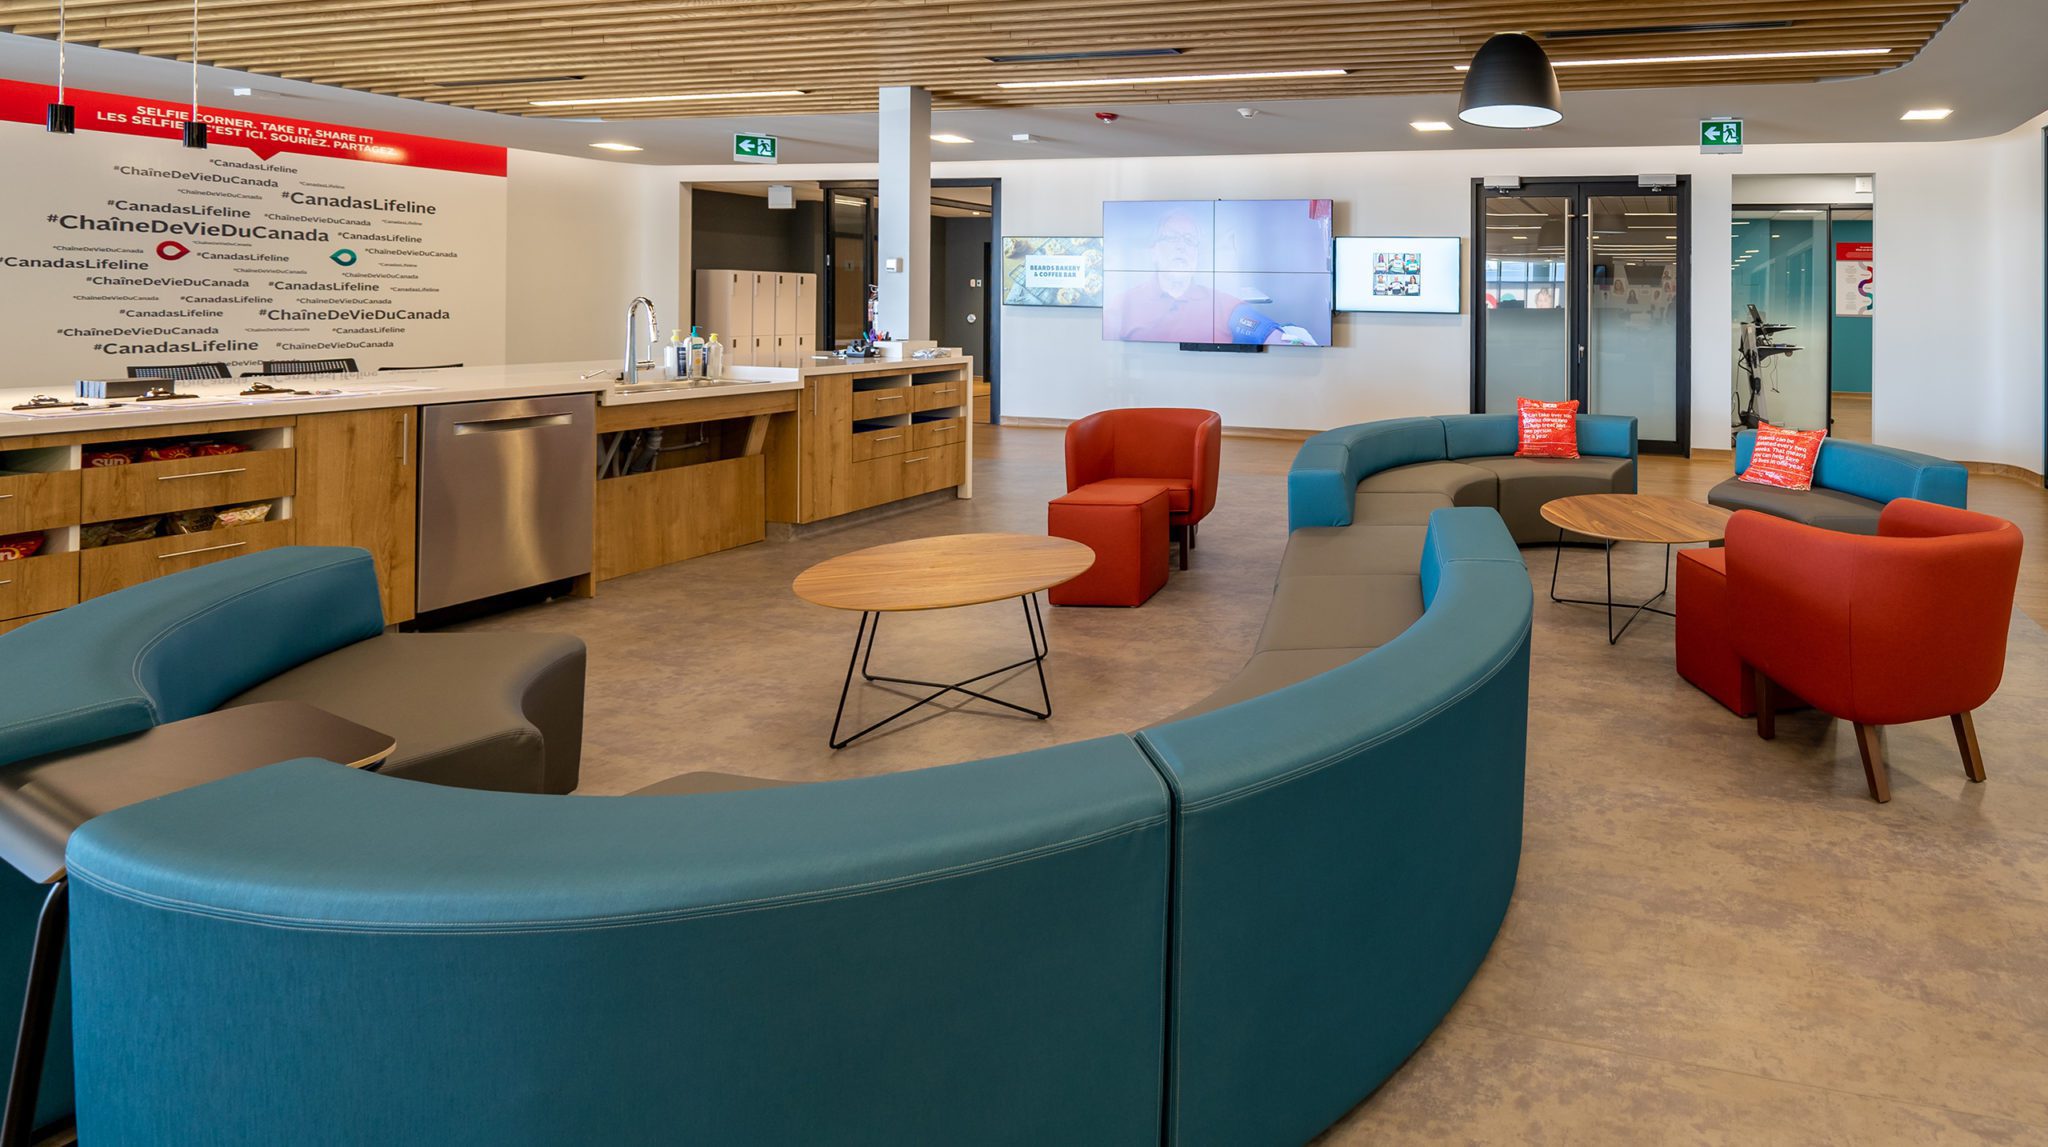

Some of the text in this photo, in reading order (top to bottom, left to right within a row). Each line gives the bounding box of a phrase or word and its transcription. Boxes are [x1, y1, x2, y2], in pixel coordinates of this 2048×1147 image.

[96, 111, 127, 122] LES
[131, 115, 185, 130] SELFIE
[246, 129, 267, 140] ICI.
[270, 133, 331, 148] SOURIEZ.
[136, 105, 189, 120] SELFIE
[195, 113, 257, 129] CORNER.
[260, 122, 295, 134] TAKE
[315, 129, 356, 142] SHARE
[359, 135, 374, 144] IT!
[209, 158, 298, 175] #CanadasLifeline
[113, 165, 279, 188] #ChaîneDeVieDuCanada
[107, 199, 251, 219] #CanadasLifeline
[281, 191, 437, 215] #CanadasLifeline
[264, 213, 372, 227] #ChaîneDeVieDuCanada
[47, 213, 330, 242] #ChaîneDeVieDuCanada
[337, 231, 423, 244] #CanadasLifeline
[196, 252, 290, 262] #CanadasLifeline
[365, 247, 458, 258] #ChaîneDeVieDuCanada
[86, 276, 250, 288] #ChaîneDeVieDuCanada
[268, 281, 380, 292] #CanadasLifeline
[180, 295, 274, 304] #CanadasLifeline
[119, 309, 224, 318] #CanadasLifeline
[258, 308, 451, 321] #ChaîneDeVieDuCanada
[57, 326, 220, 337] #ChaîneDeVieDuCanada
[332, 326, 406, 335] #CanadasLifeline
[93, 339, 260, 355] #CanadasLifeline
[276, 340, 395, 351] #ChaîneDeVieDuCanada
